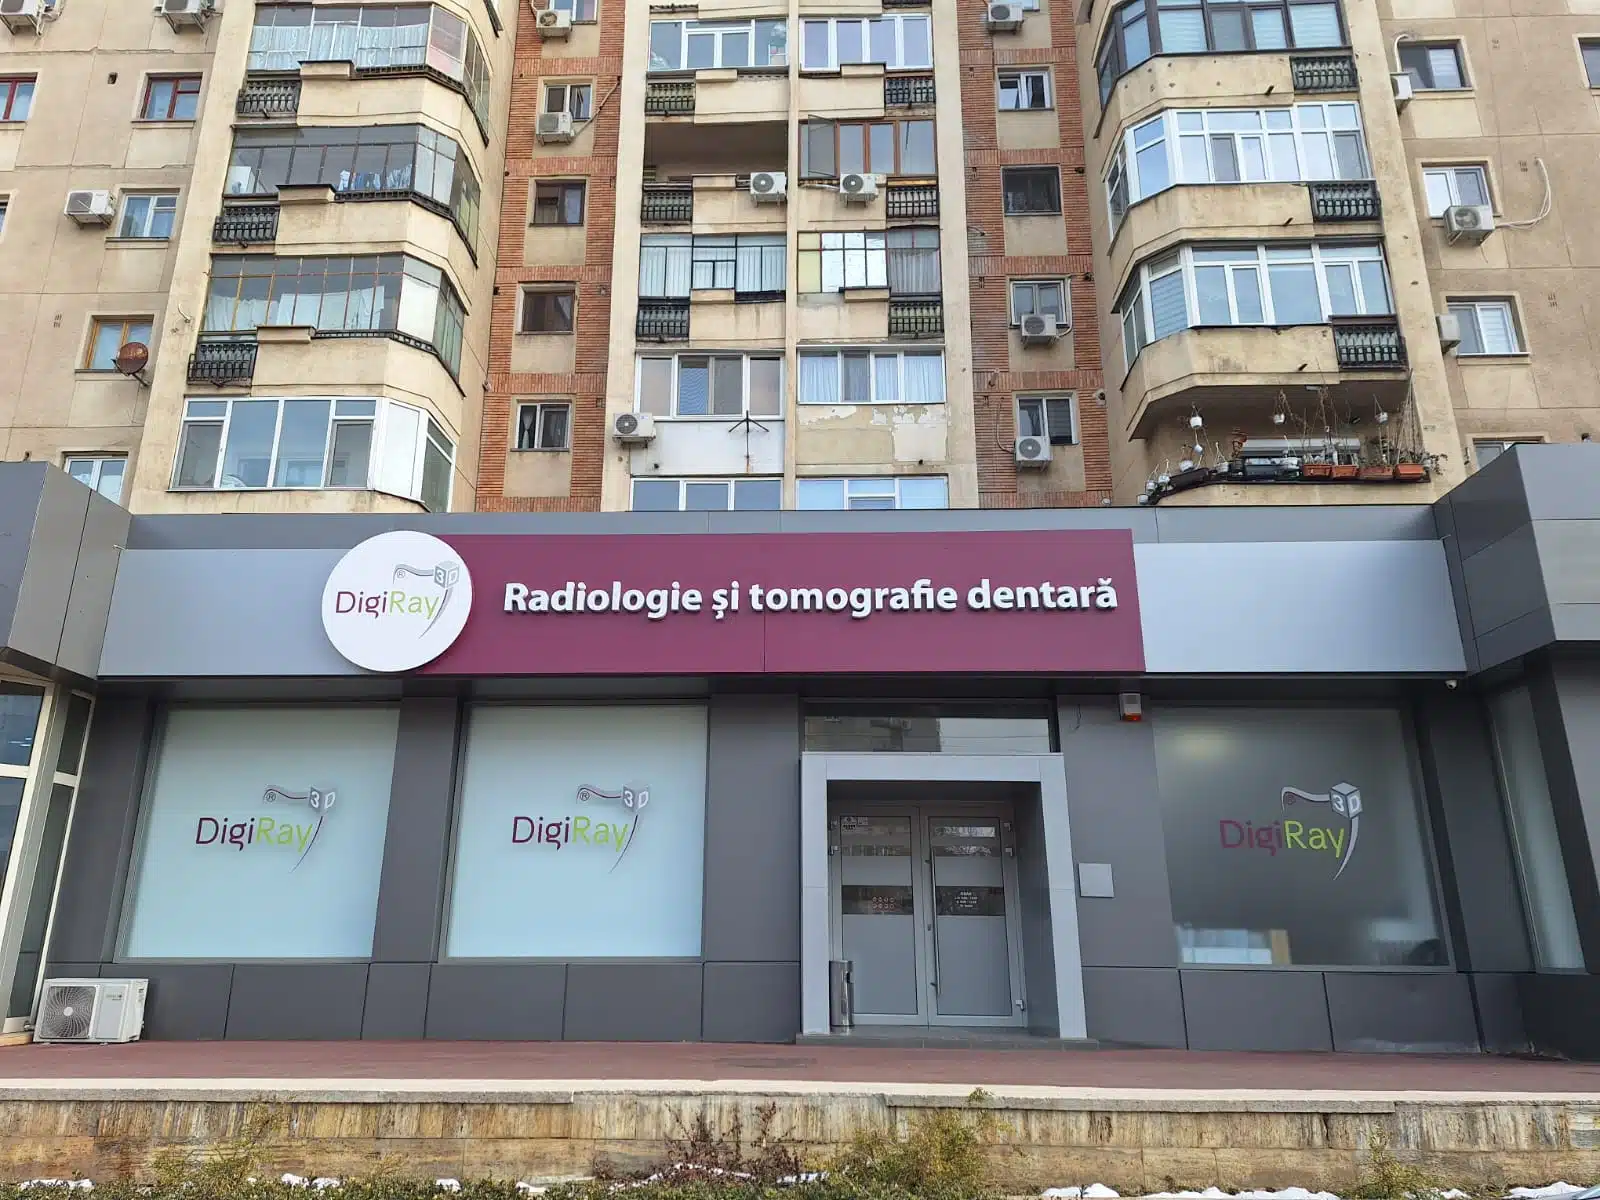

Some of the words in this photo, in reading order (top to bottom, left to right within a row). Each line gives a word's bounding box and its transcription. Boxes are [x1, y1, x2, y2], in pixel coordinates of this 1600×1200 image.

[335, 590, 439, 619] DigiRay
[503, 581, 703, 620] Radiologie
[749, 578, 958, 619] tomografie
[967, 577, 1118, 610] dentară
[310, 790, 336, 809] 3D
[623, 790, 649, 809] 3D
[1332, 793, 1362, 815] 3D
[195, 816, 314, 853] DigiRay
[511, 816, 629, 852] DigiRay
[1219, 819, 1345, 858] DigiRay
